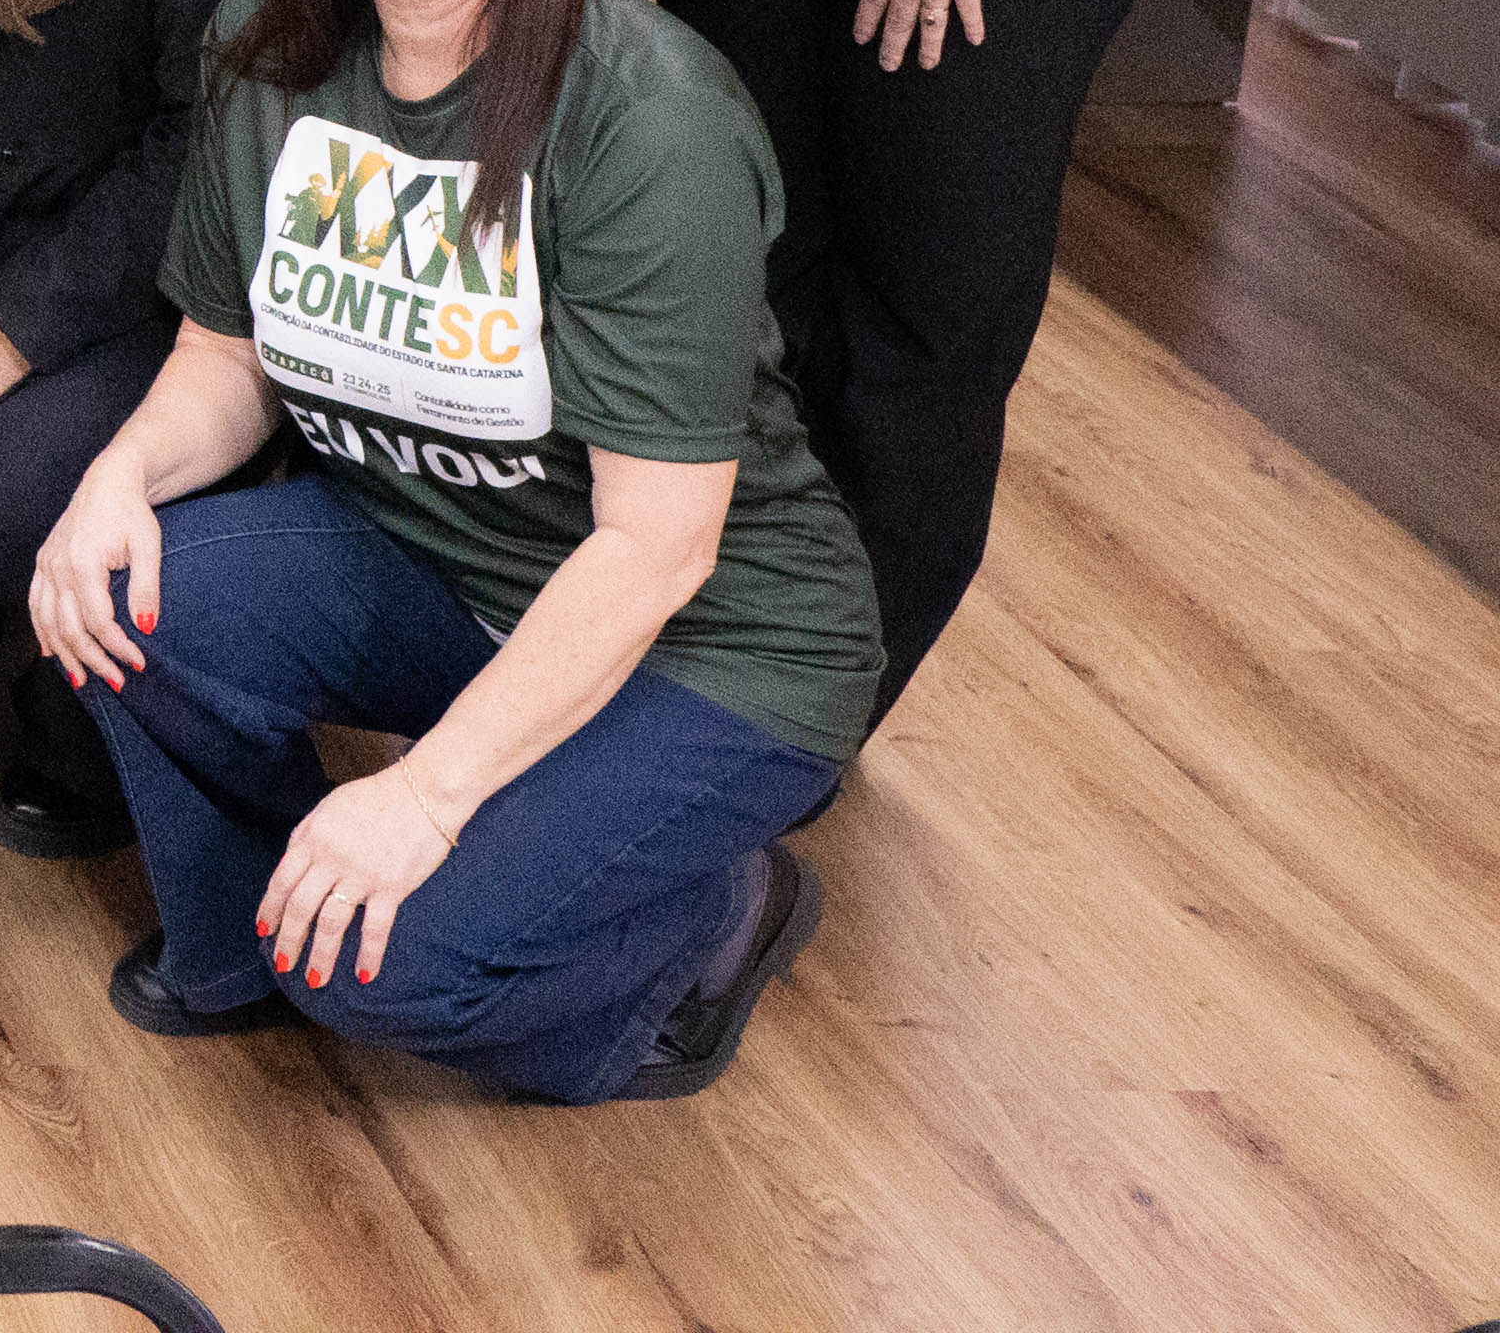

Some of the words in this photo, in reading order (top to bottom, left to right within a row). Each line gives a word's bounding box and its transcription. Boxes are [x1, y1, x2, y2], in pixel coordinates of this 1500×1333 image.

[269, 250, 520, 364] CONTESC
[343, 373, 356, 385] 23
[358, 377, 371, 389] 24
[377, 382, 391, 395] 25
[379, 345, 391, 357] DO
[392, 350, 423, 367] ESTADO
[424, 359, 436, 371] DE
[436, 362, 468, 377] SANTA
[469, 367, 524, 379] CATARINA
[283, 398, 365, 465] EU
